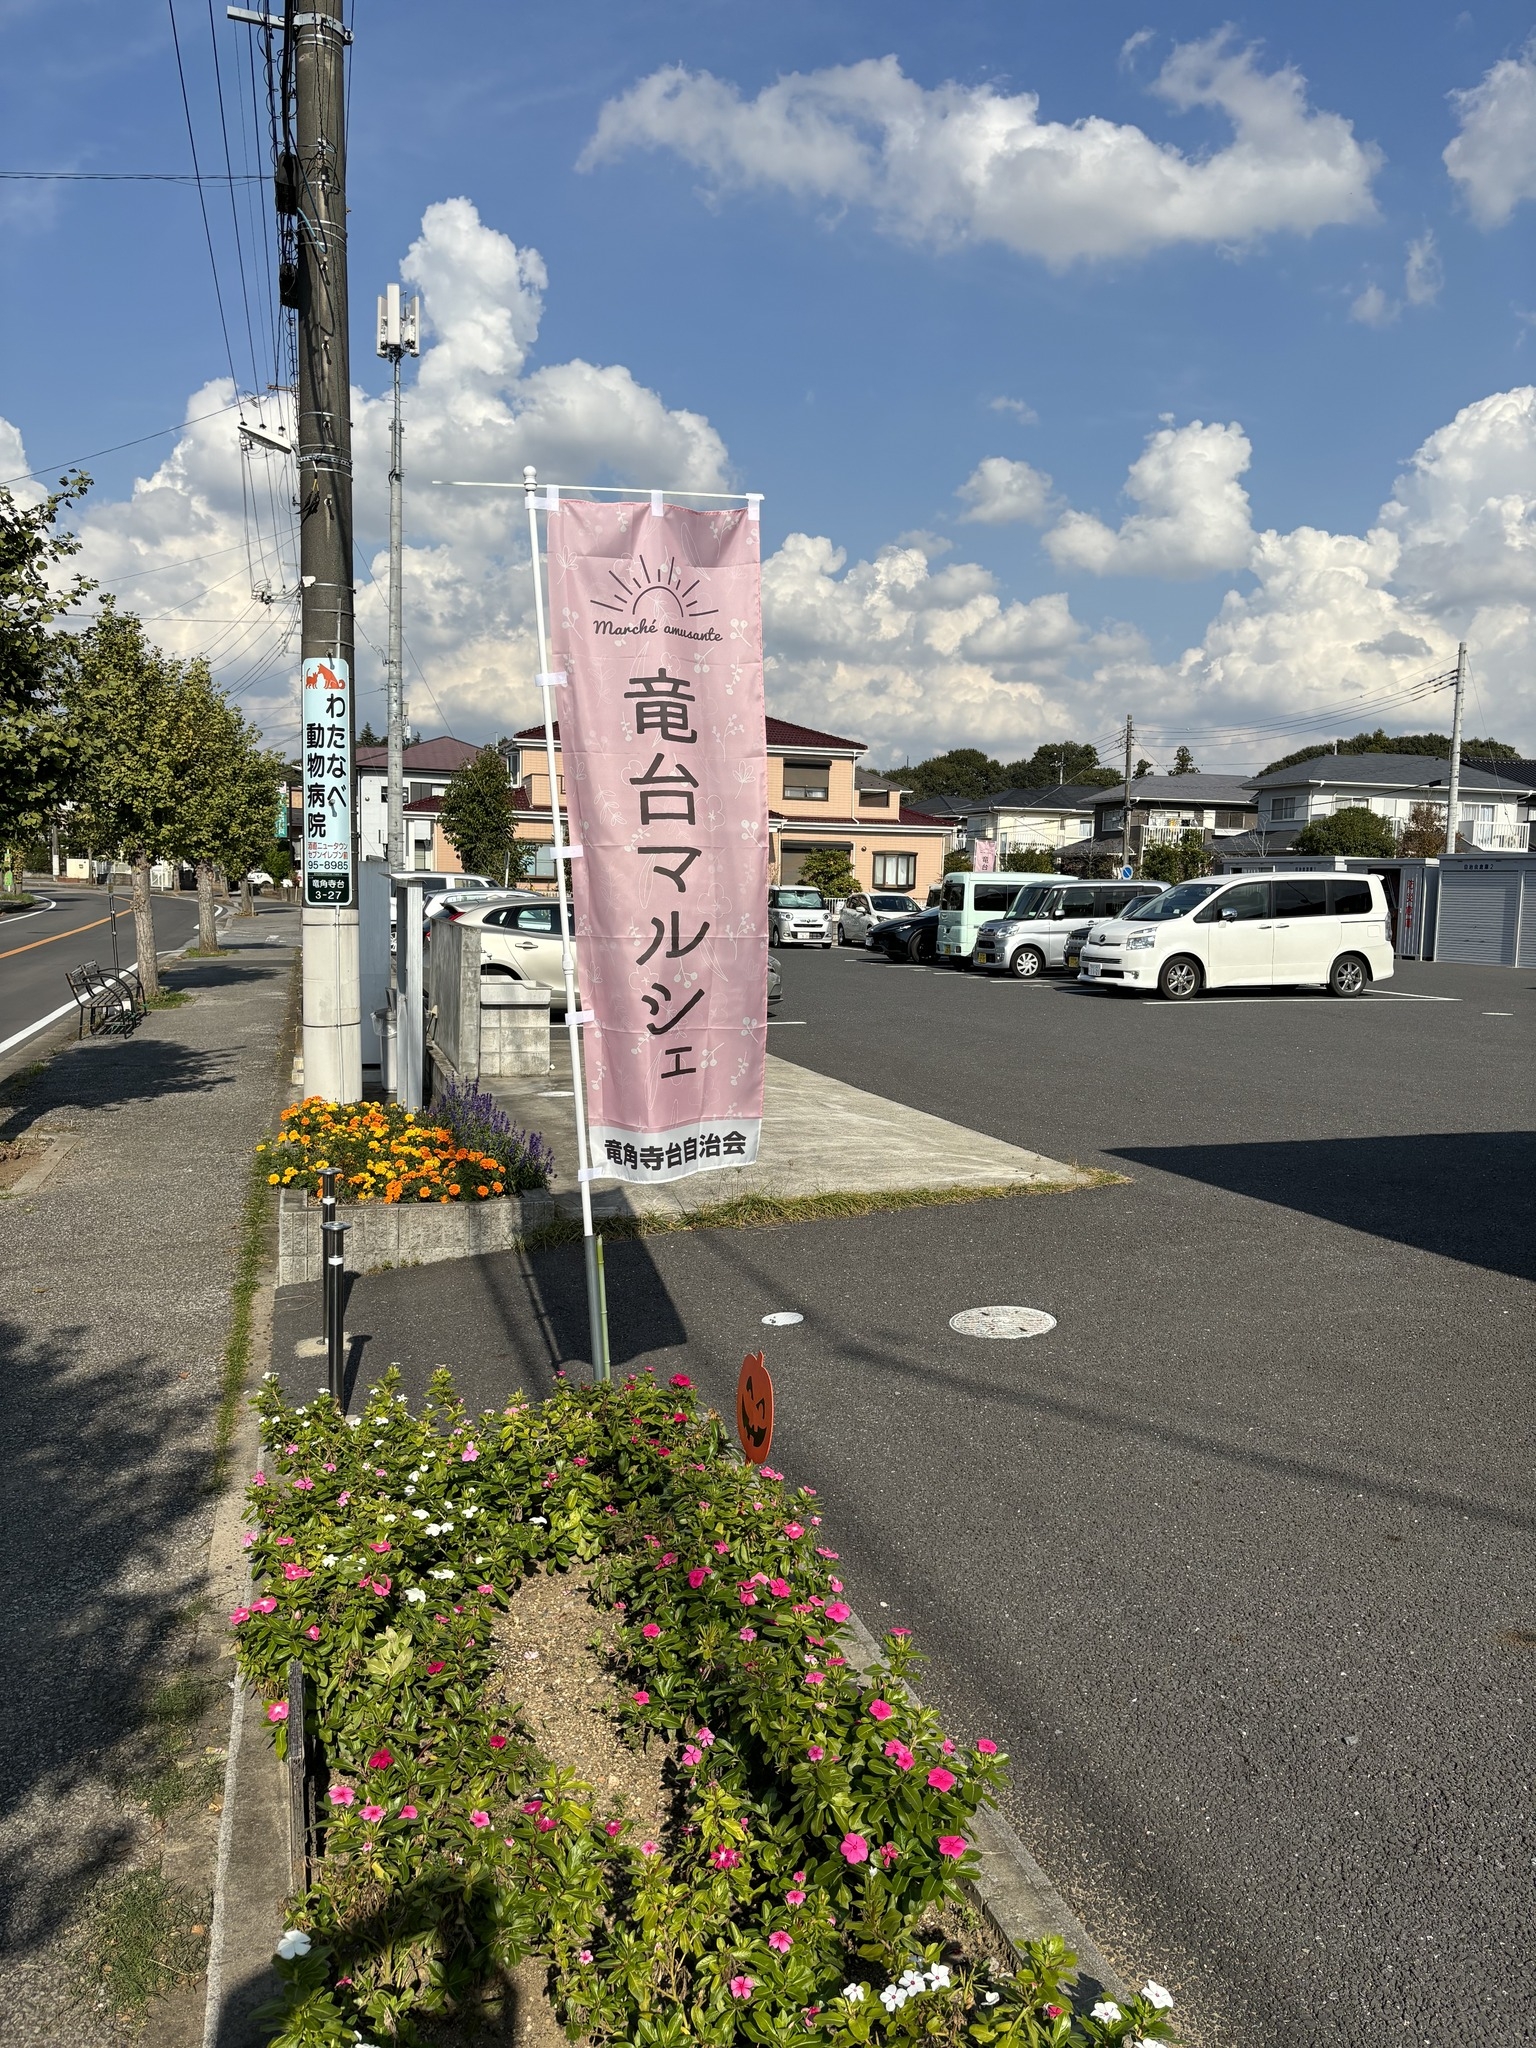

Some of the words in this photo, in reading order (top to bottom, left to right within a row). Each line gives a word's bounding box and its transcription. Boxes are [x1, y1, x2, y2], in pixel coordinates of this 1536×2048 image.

[593, 618, 658, 635] Marché
[663, 627, 723, 641] amusante
[325, 693, 347, 808] わたなべ
[306, 722, 326, 838] 動物病院
[307, 860, 349, 870] 95-8985
[623, 667, 710, 1079] 竜台マルシェ
[312, 879, 345, 889] 竜角寺台
[315, 890, 342, 900] 3-27
[604, 1131, 747, 1171] 竜角寺台自治会
